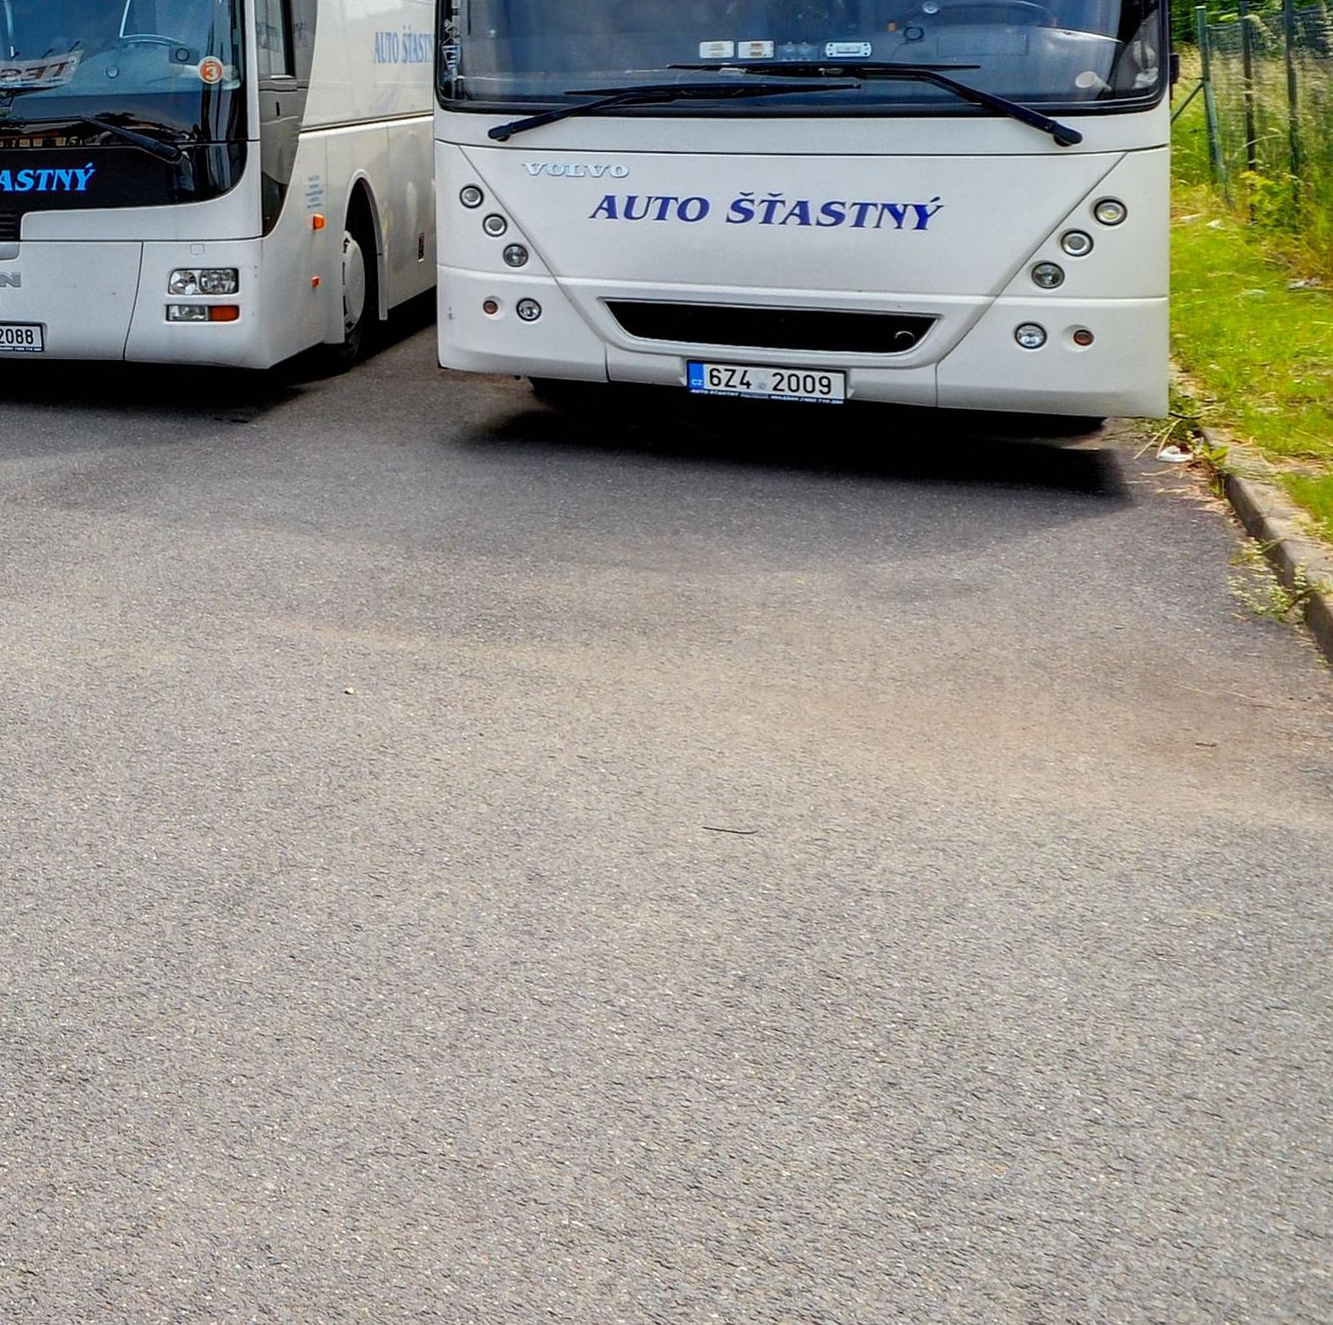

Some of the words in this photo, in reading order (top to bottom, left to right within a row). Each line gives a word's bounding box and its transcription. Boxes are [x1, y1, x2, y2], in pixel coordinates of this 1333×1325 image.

[374, 30, 399, 64] AUTO
[204, 62, 217, 81] 3
[522, 162, 630, 178] VOLVO
[588, 195, 710, 222] AUTO
[726, 191, 944, 231] ŠŤASTNÝ
[709, 367, 752, 389] 6Z4
[771, 372, 832, 395] 2009
